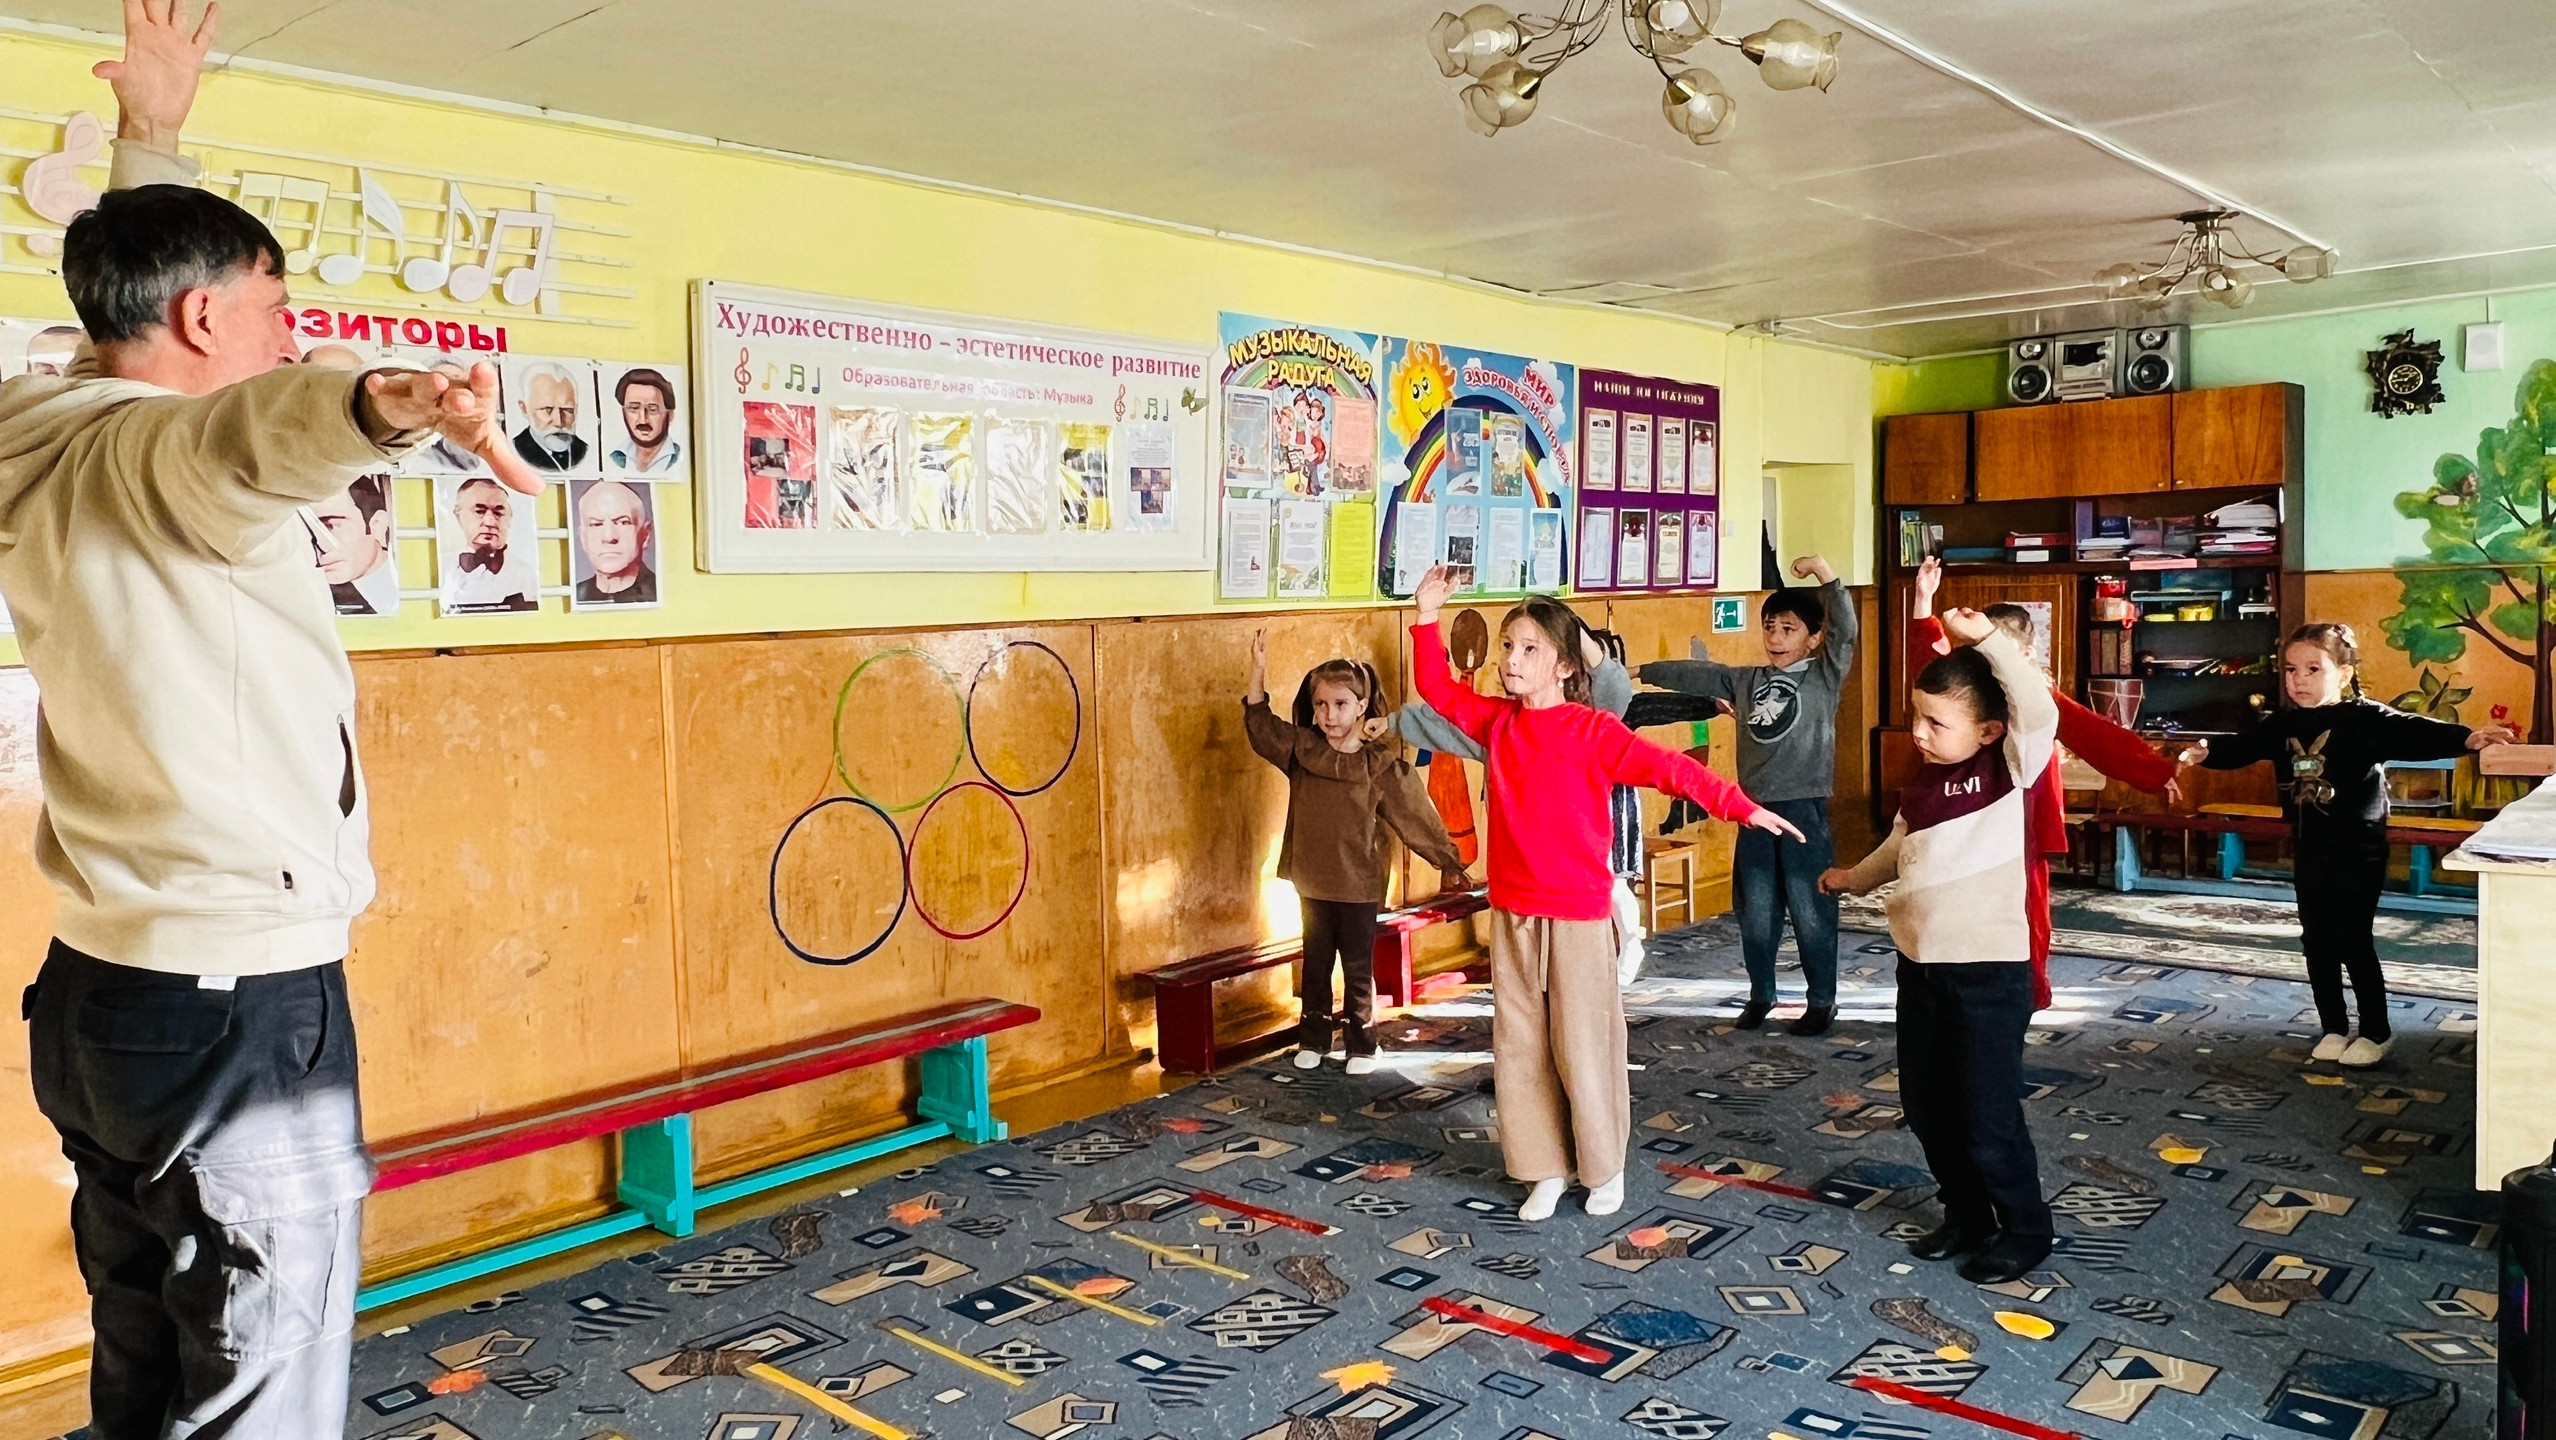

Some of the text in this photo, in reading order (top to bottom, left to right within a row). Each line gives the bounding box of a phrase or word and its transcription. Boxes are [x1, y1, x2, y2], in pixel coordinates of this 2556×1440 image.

[717, 302, 932, 351] Художественно
[1112, 354, 1201, 379] развитие
[1228, 328, 1373, 385] МУЗЫКАЛЬНАЯ
[1267, 359, 1336, 389] РАДУГА
[1463, 369, 1529, 404] ЗДОРОВЬЯ
[1523, 366, 1555, 407] МИР
[1043, 387, 1094, 406] Музыка
